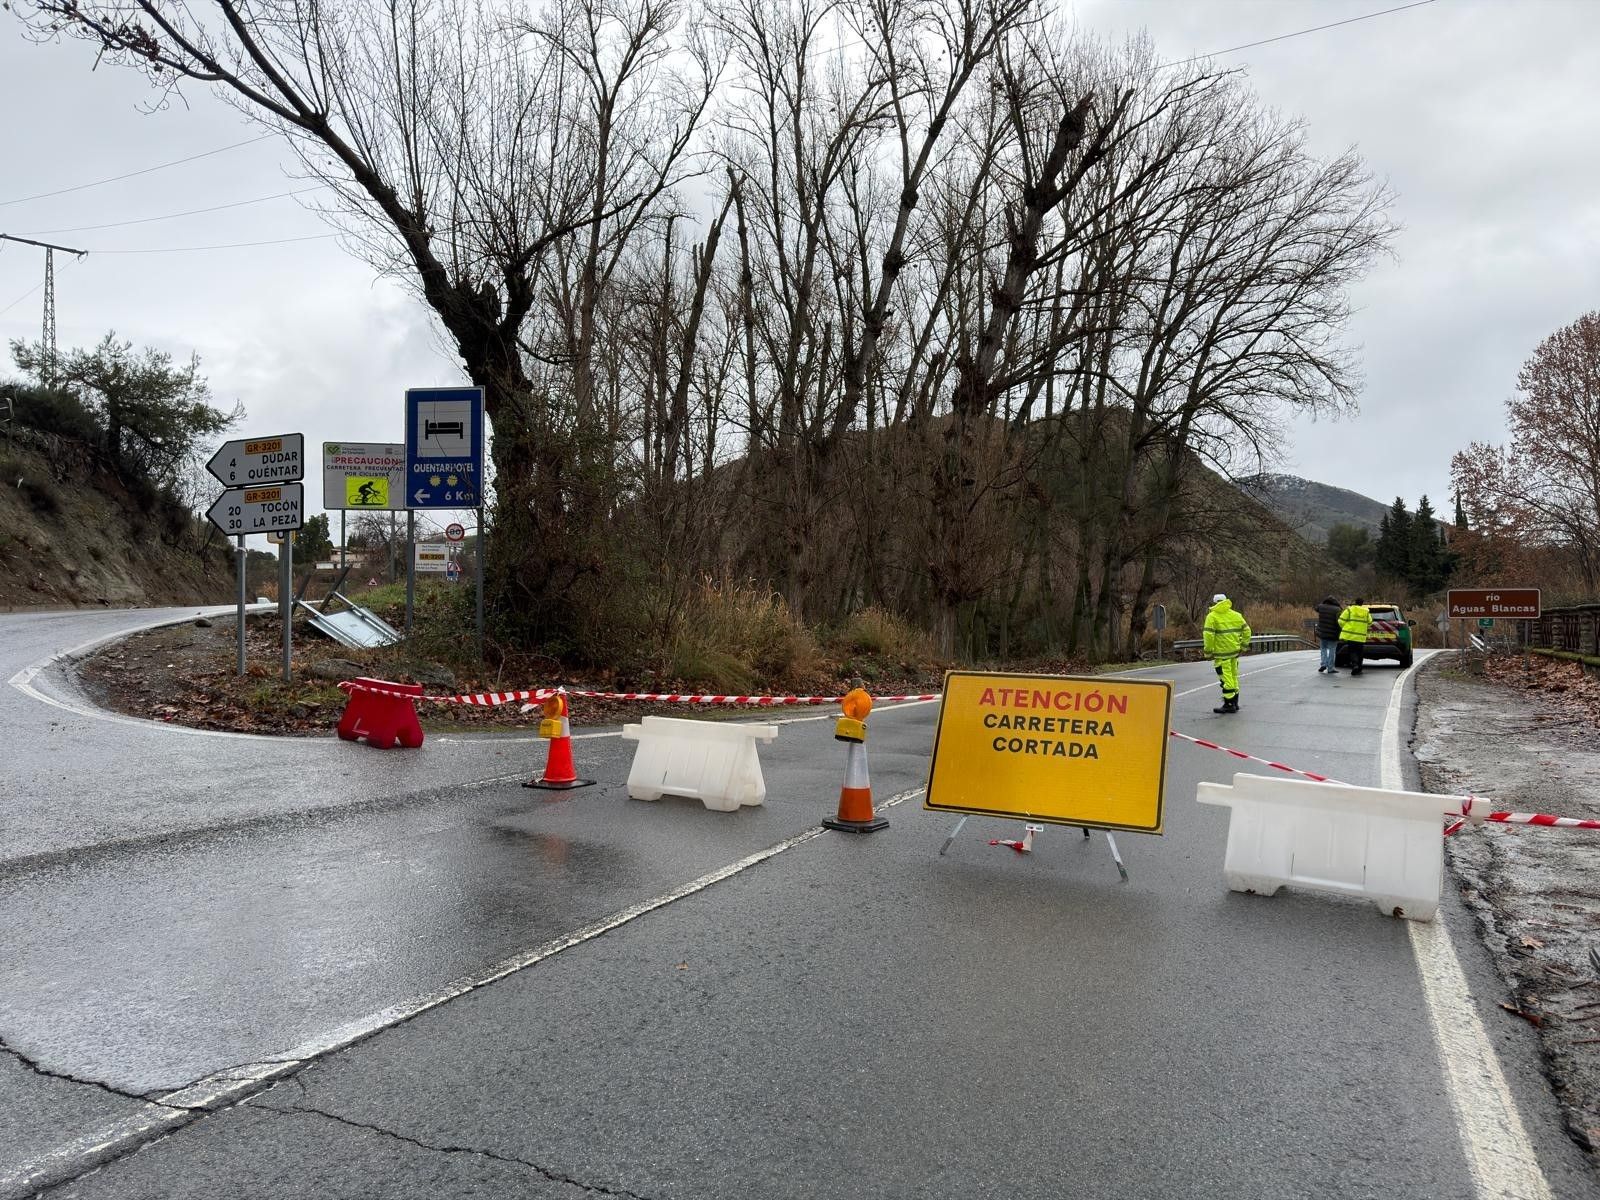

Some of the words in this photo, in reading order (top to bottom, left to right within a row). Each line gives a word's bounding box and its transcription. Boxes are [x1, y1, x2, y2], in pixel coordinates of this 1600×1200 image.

[247, 442, 280, 452] GR-3201
[230, 458, 236, 467] 4
[262, 452, 298, 464] DÚDAR
[230, 472, 236, 480] 6
[248, 465, 298, 480] QUÉNTAR
[246, 490, 280, 501] GR-3201
[444, 491, 452, 500] 6
[228, 506, 241, 516] 20
[261, 500, 298, 512] TOCÓN
[229, 520, 242, 529] 30
[254, 518, 265, 528] LA
[272, 514, 297, 526] PEZA
[1486, 593, 1500, 601] río
[1452, 605, 1486, 614] Aguas
[979, 688, 1128, 714] ATENCIÓN
[984, 714, 1114, 737] CARRETERA
[992, 736, 1098, 760] CORTADA
